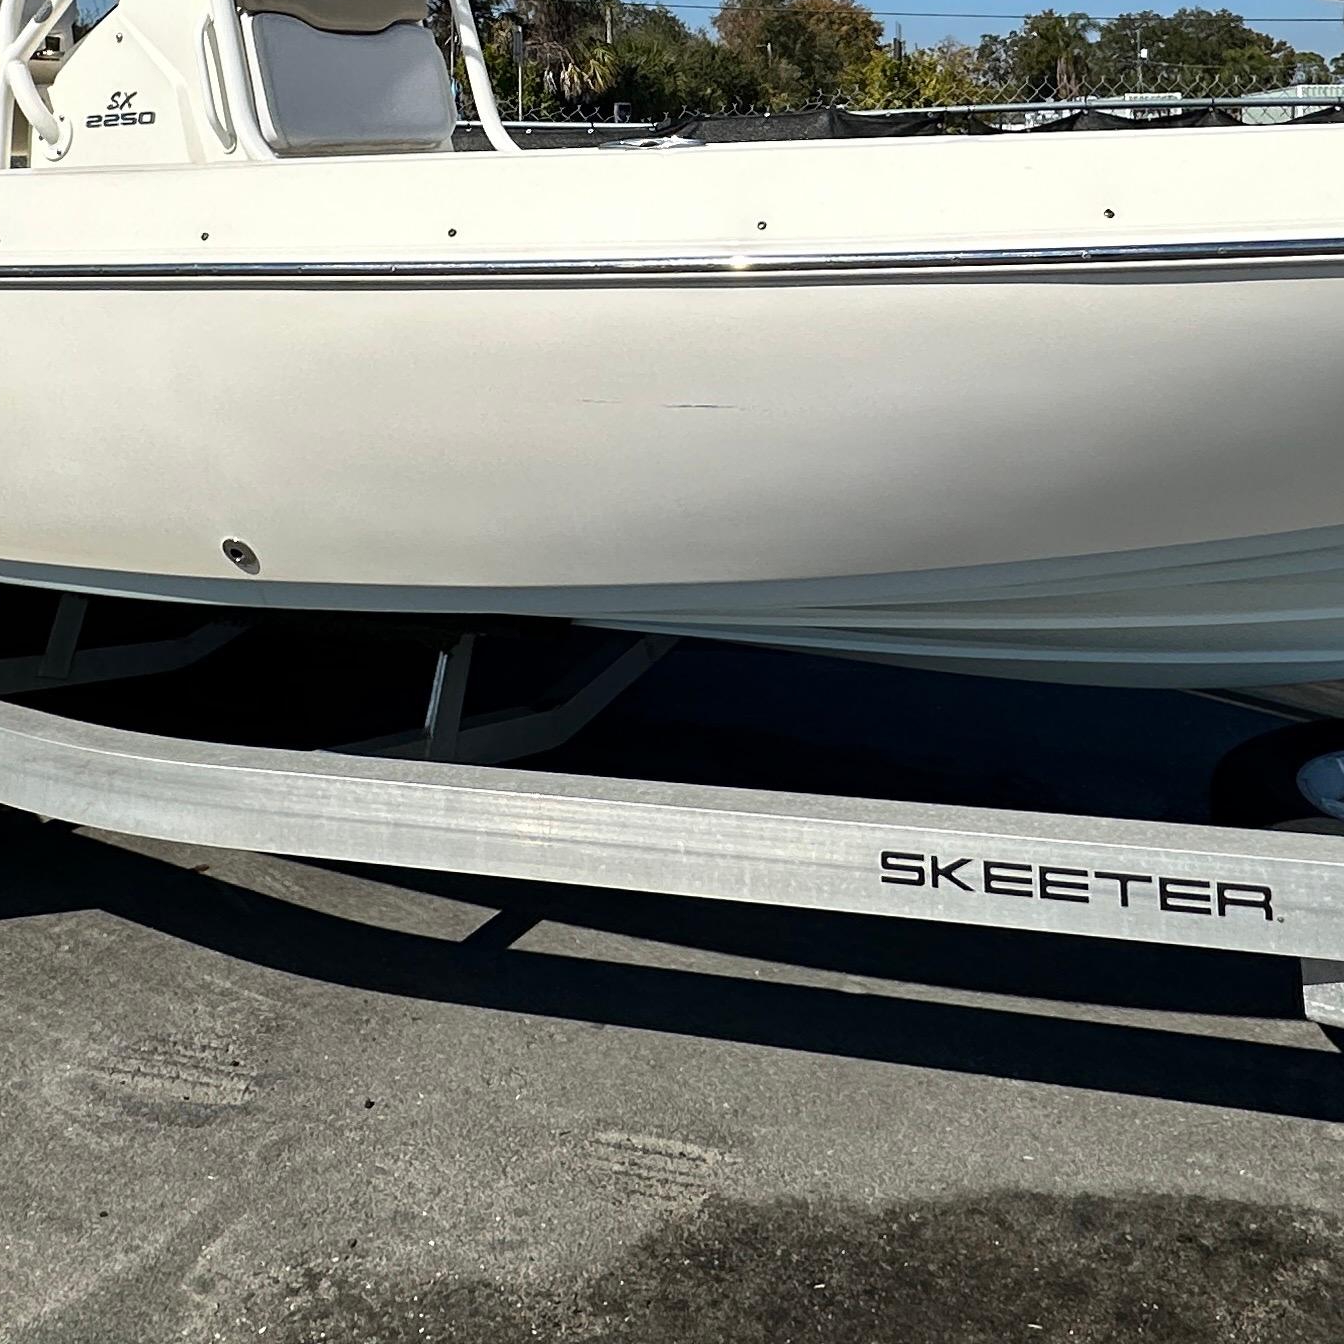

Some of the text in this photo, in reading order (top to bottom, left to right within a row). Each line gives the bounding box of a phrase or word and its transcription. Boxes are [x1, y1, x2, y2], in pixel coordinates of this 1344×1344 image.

[106, 91, 138, 110] SX
[86, 111, 156, 128] 2250
[880, 851, 1274, 921] SKEETER
